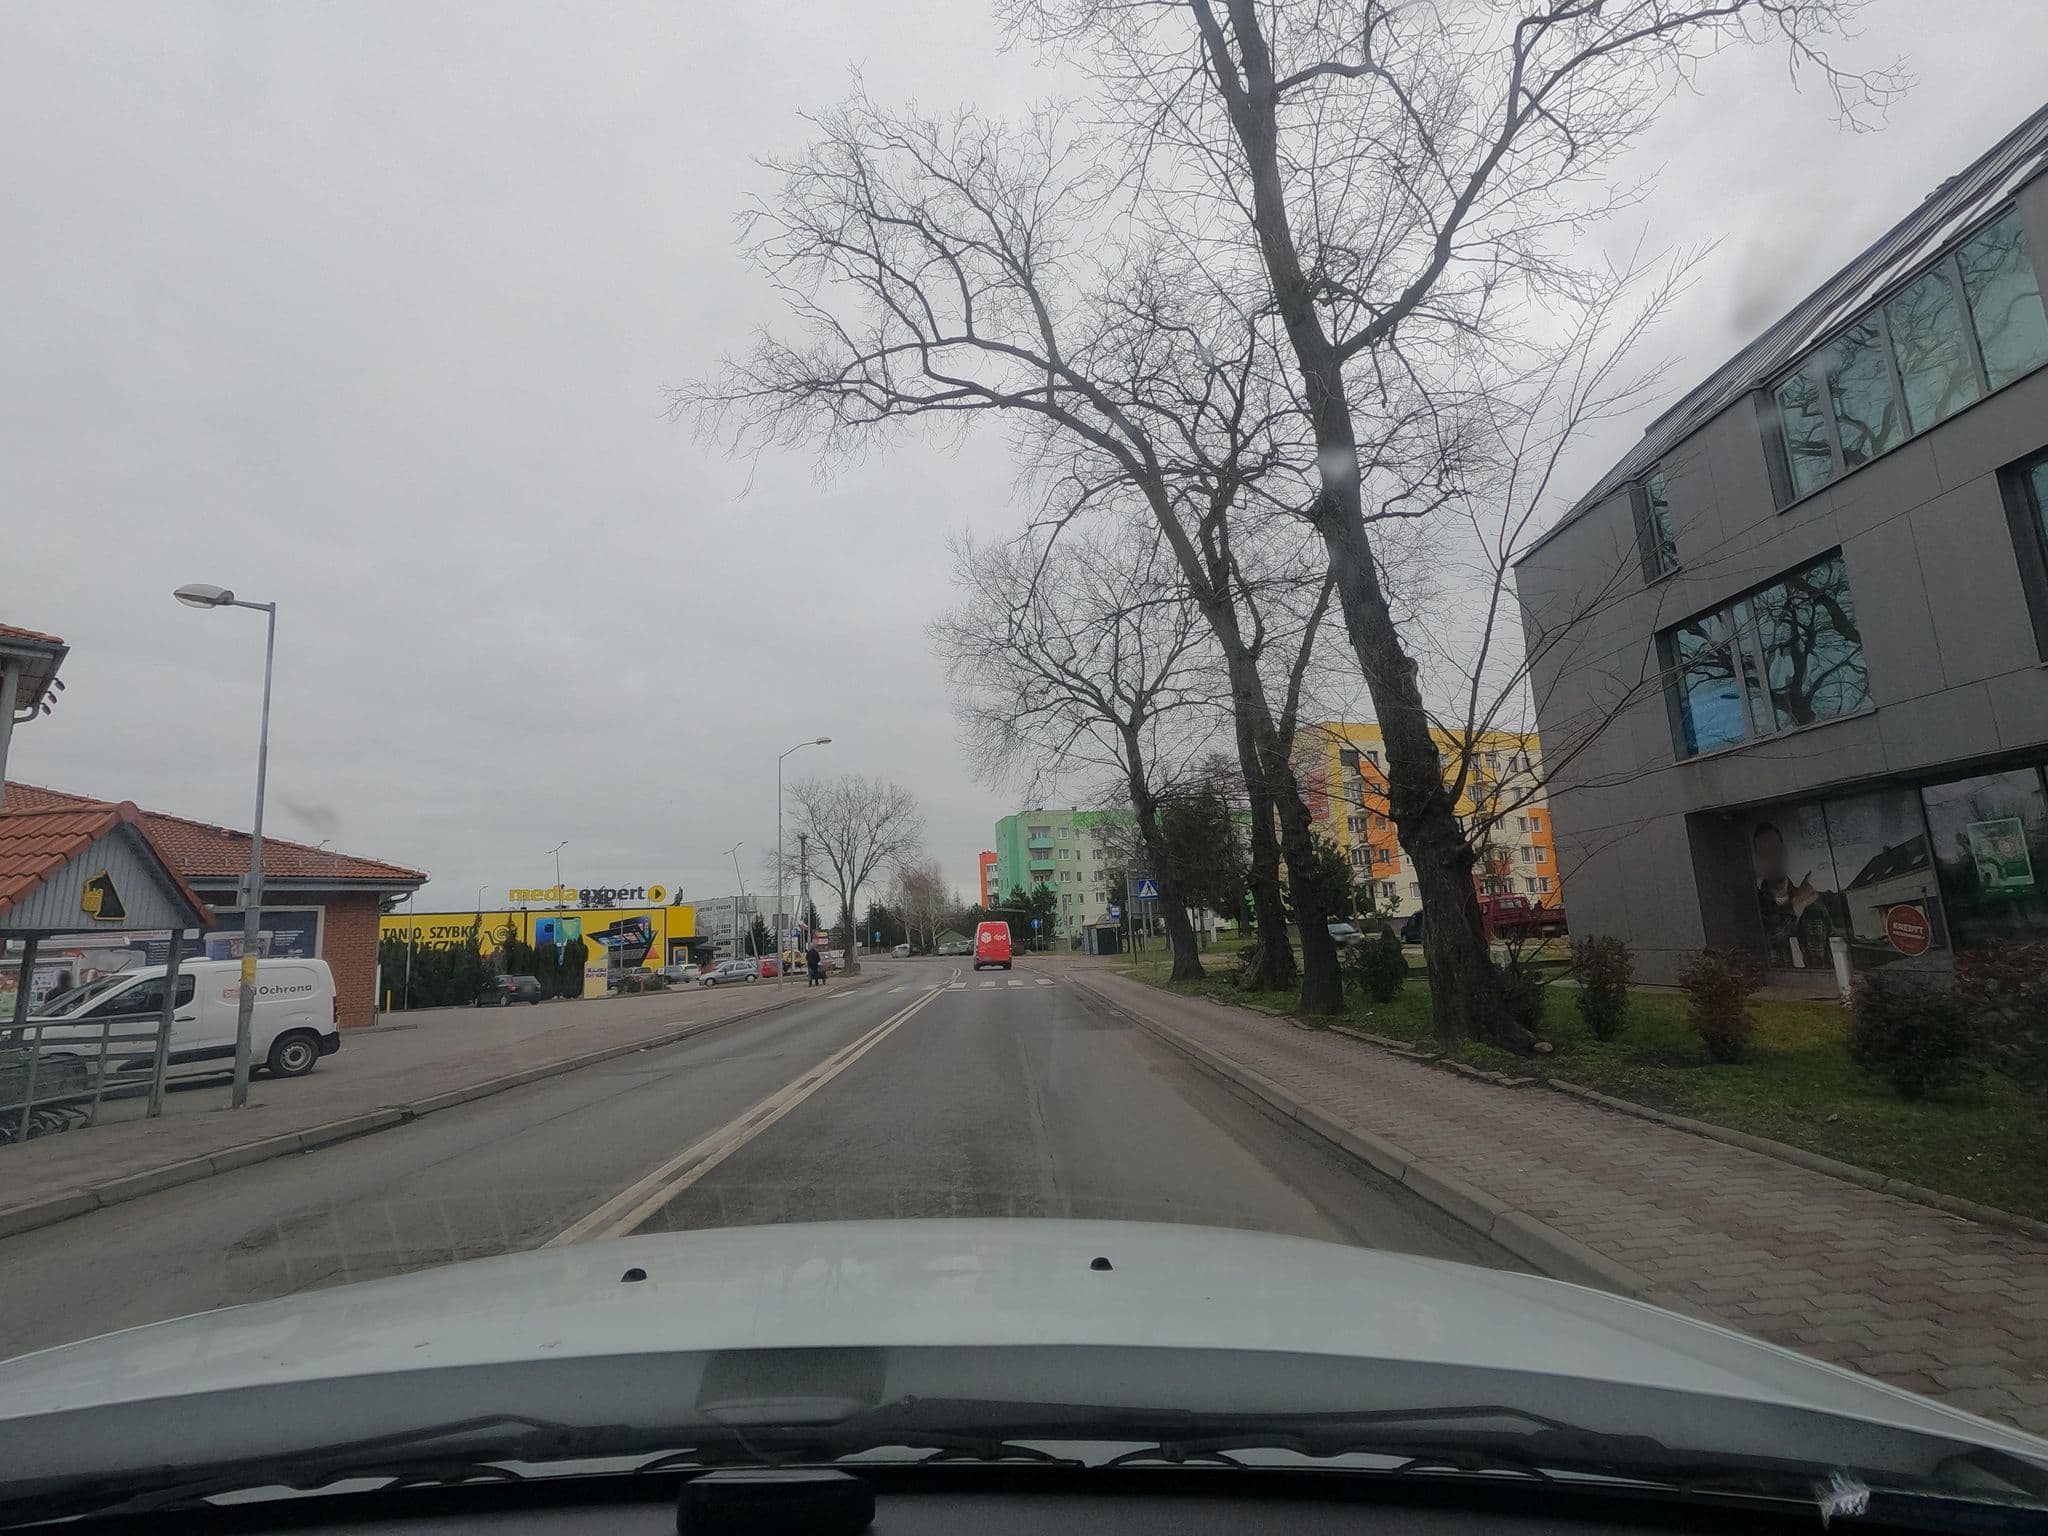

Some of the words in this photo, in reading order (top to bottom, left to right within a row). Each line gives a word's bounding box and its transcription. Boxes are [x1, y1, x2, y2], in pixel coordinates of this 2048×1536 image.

[382, 927, 424, 941] TANO,
[994, 933, 1006, 942] dpd
[259, 984, 312, 995] Ochrona
